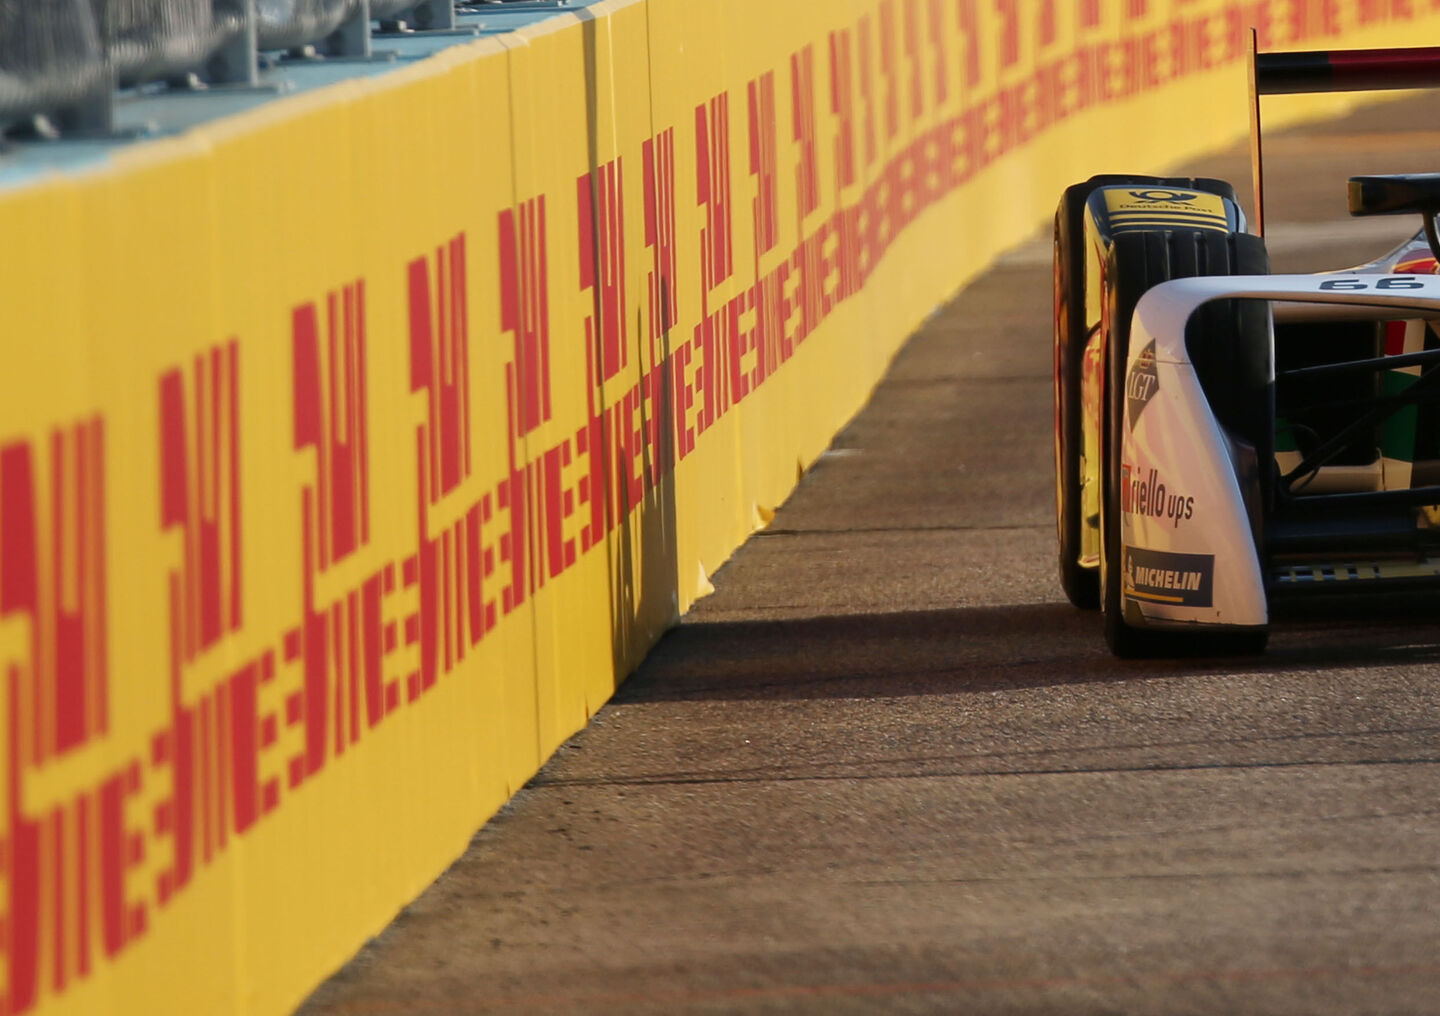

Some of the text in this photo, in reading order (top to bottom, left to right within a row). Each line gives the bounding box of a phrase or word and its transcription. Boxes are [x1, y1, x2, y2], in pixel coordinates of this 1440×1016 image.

[1319, 277, 1424, 290] 66
[1128, 372, 1156, 402] LGT
[1131, 467, 1194, 528] riello ups
[1135, 566, 1203, 591] MICHELIN
